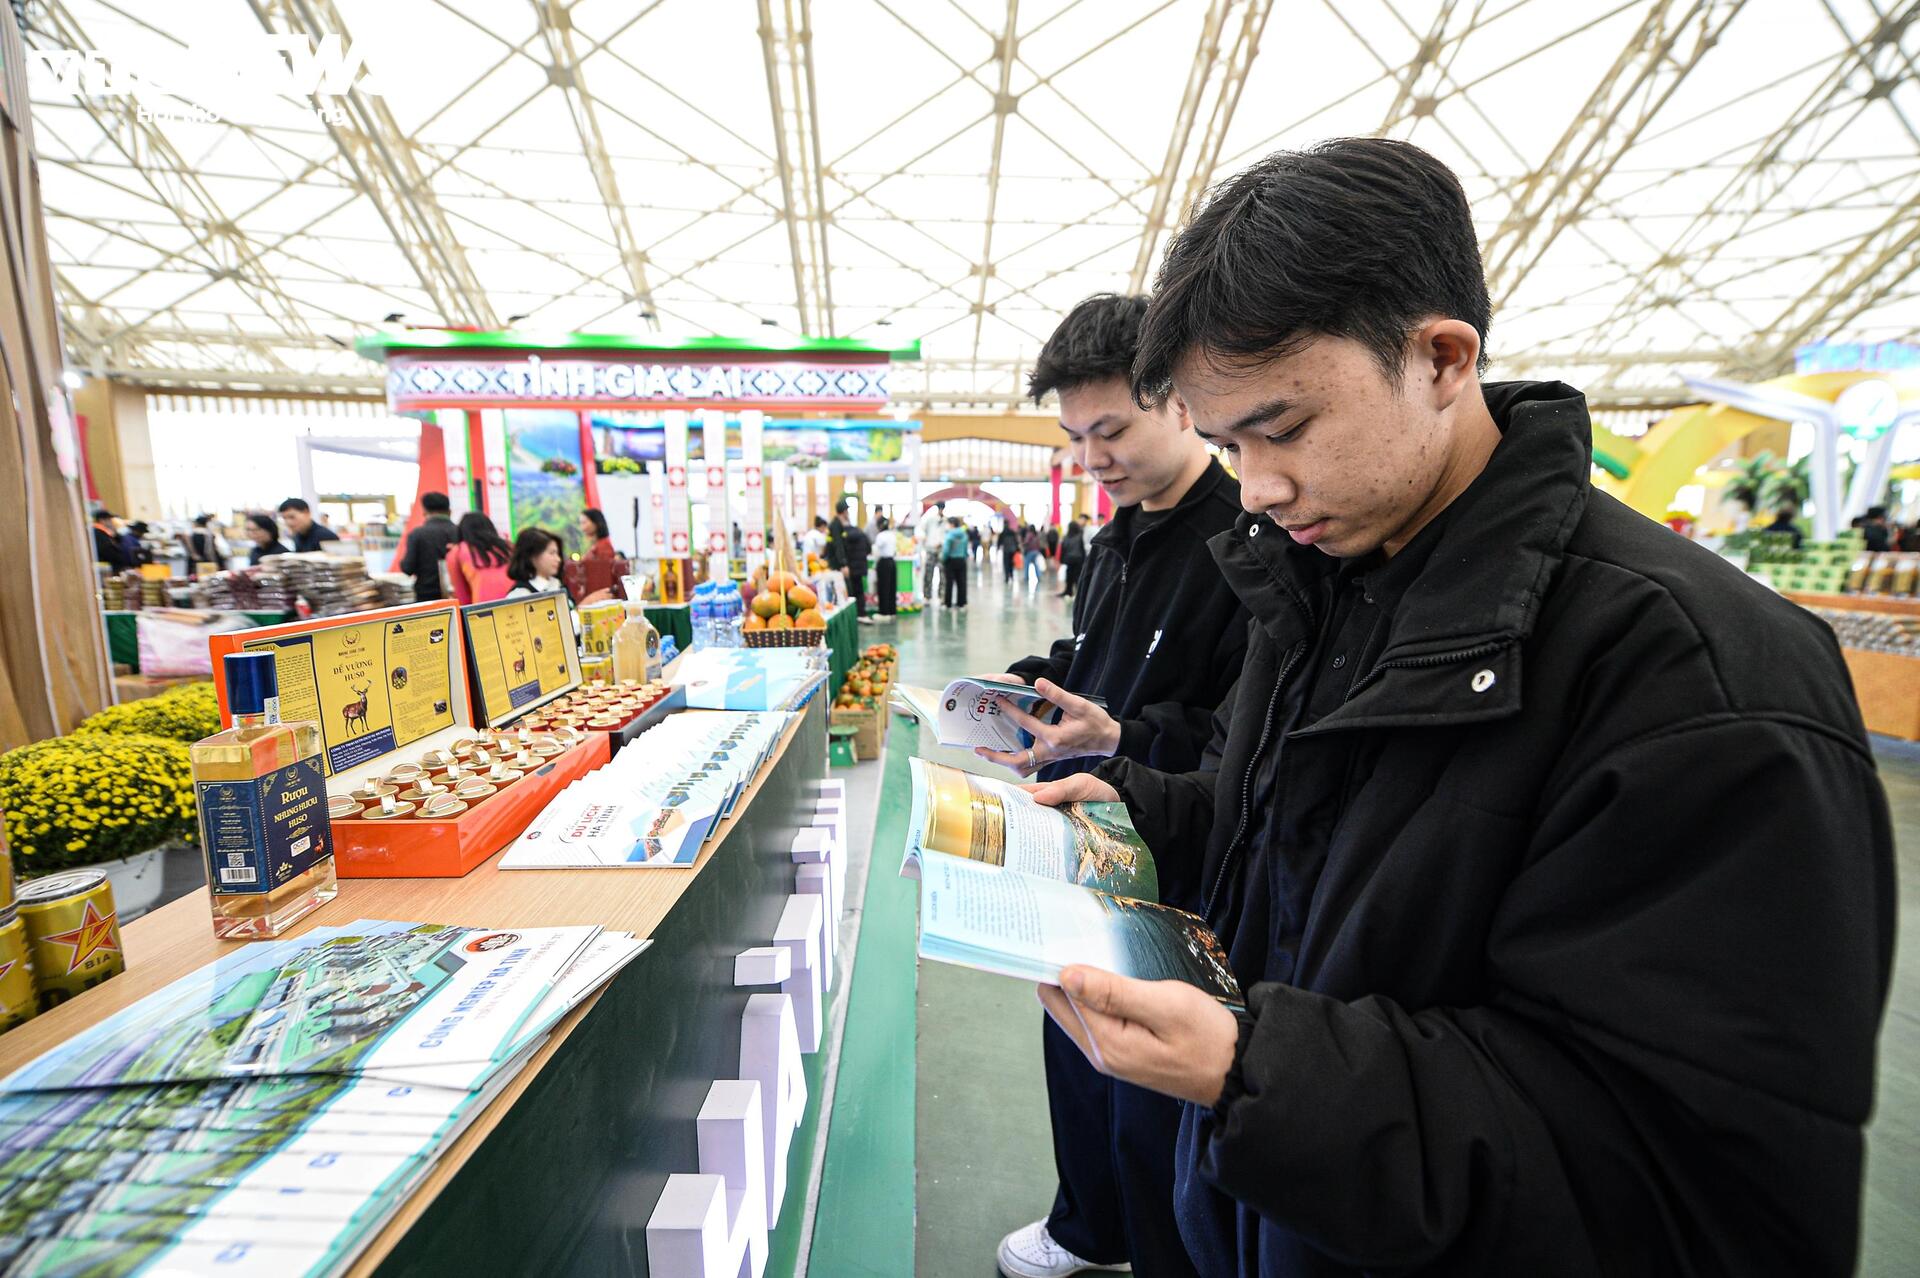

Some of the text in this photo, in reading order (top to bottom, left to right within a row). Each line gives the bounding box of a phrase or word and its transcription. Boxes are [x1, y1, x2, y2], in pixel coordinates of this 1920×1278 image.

[604, 364, 673, 397] GIA
[680, 365, 743, 398] LAI
[84, 953, 112, 971] BIA
